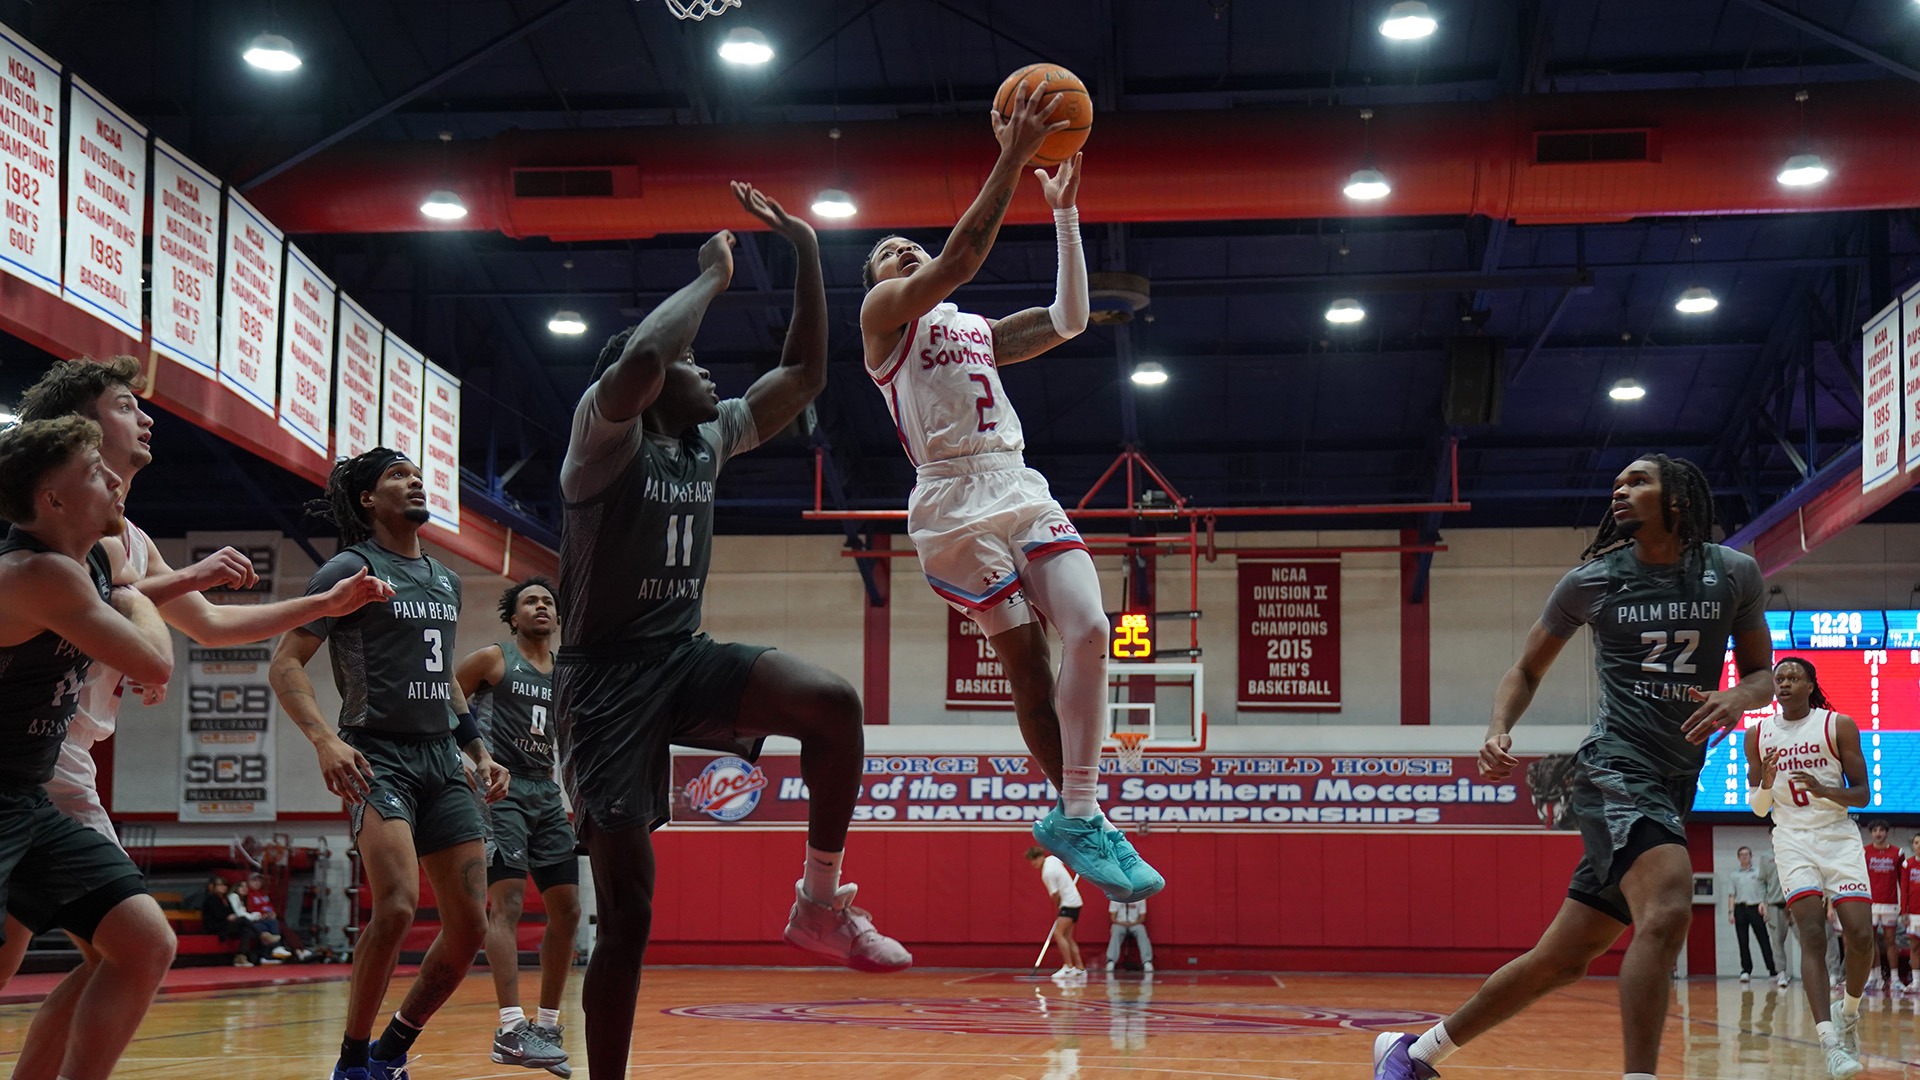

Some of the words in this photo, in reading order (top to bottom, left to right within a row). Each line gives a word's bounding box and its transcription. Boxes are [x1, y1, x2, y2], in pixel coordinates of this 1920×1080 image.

[8, 56, 36, 91] NCAA
[0, 76, 39, 118] IVISION
[44, 105, 53, 126] II
[0, 104, 48, 150] NATIONAL
[96, 117, 122, 152] NCAA
[0, 130, 55, 178] HAMPIONS
[80, 135, 125, 183] DIVISION
[5, 162, 40, 206] 1982
[84, 169, 131, 216] NATIONAL
[176, 175, 200, 202] NCAA
[6, 200, 39, 233] MEN'S
[77, 196, 136, 248] CHAMPIONS
[163, 188, 203, 228] DIVISION
[9, 228, 35, 256] GOLF
[166, 215, 208, 254] NATIONAL
[90, 234, 122, 275] 1985
[160, 235, 214, 278] CHAMPIONS
[80, 265, 128, 309] BASEBALL
[172, 266, 201, 302] 1985
[235, 259, 271, 300] NATIONAL
[172, 297, 200, 325] MEN'S
[231, 276, 274, 322] CHAMPIONS
[175, 321, 196, 346] GOLF
[238, 335, 261, 365] MEN'S
[920, 347, 993, 370] Southe
[240, 359, 257, 383] GOLF
[969, 373, 997, 432] 2
[1876, 447, 1888, 466] GOLF
[643, 476, 678, 503] PALM
[679, 481, 712, 502] BEACH
[665, 515, 694, 566] 11
[1272, 567, 1307, 582] NCAA
[1254, 585, 1310, 600] DIVISION
[1314, 585, 1328, 600] II
[394, 601, 426, 619] PALM
[1258, 603, 1321, 618] NATIONAL
[1618, 603, 1662, 624] PALM
[1668, 601, 1721, 620] BEACH
[1114, 626, 1150, 657] 25
[1251, 621, 1328, 636] CHAMPIONS
[1810, 636, 1846, 648] PERIOD
[1851, 636, 1857, 648] 1
[424, 628, 443, 672] 3
[977, 639, 996, 658] 19
[1267, 639, 1312, 659] 2015
[1640, 630, 1700, 674] 22
[1863, 650, 1887, 664] PTS
[976, 662, 1003, 676] MEN
[1269, 662, 1310, 677] MEN'S
[189, 685, 270, 713] SCB
[408, 681, 450, 700] ATLANT
[512, 681, 539, 698] PALM
[956, 679, 1012, 694] BASKETB
[1248, 680, 1331, 695] BASKETBALL
[530, 704, 547, 736] 0
[1765, 742, 1820, 757] Forida
[185, 754, 267, 783] SCB
[862, 757, 979, 775] EORGE
[988, 757, 1028, 775] W.
[1099, 758, 1201, 775] NKINS
[1212, 758, 1323, 776] FIELD
[1332, 758, 1452, 776] HOUSE
[1778, 757, 1828, 771] uthern
[870, 776, 905, 800] of
[909, 776, 958, 800] the
[1121, 778, 1302, 801] Southern
[1313, 778, 1517, 804] Moccasins
[907, 805, 1050, 820] NATION
[1108, 806, 1441, 823] CHAMPIONSHIPS
[1839, 883, 1867, 892] MOCS
